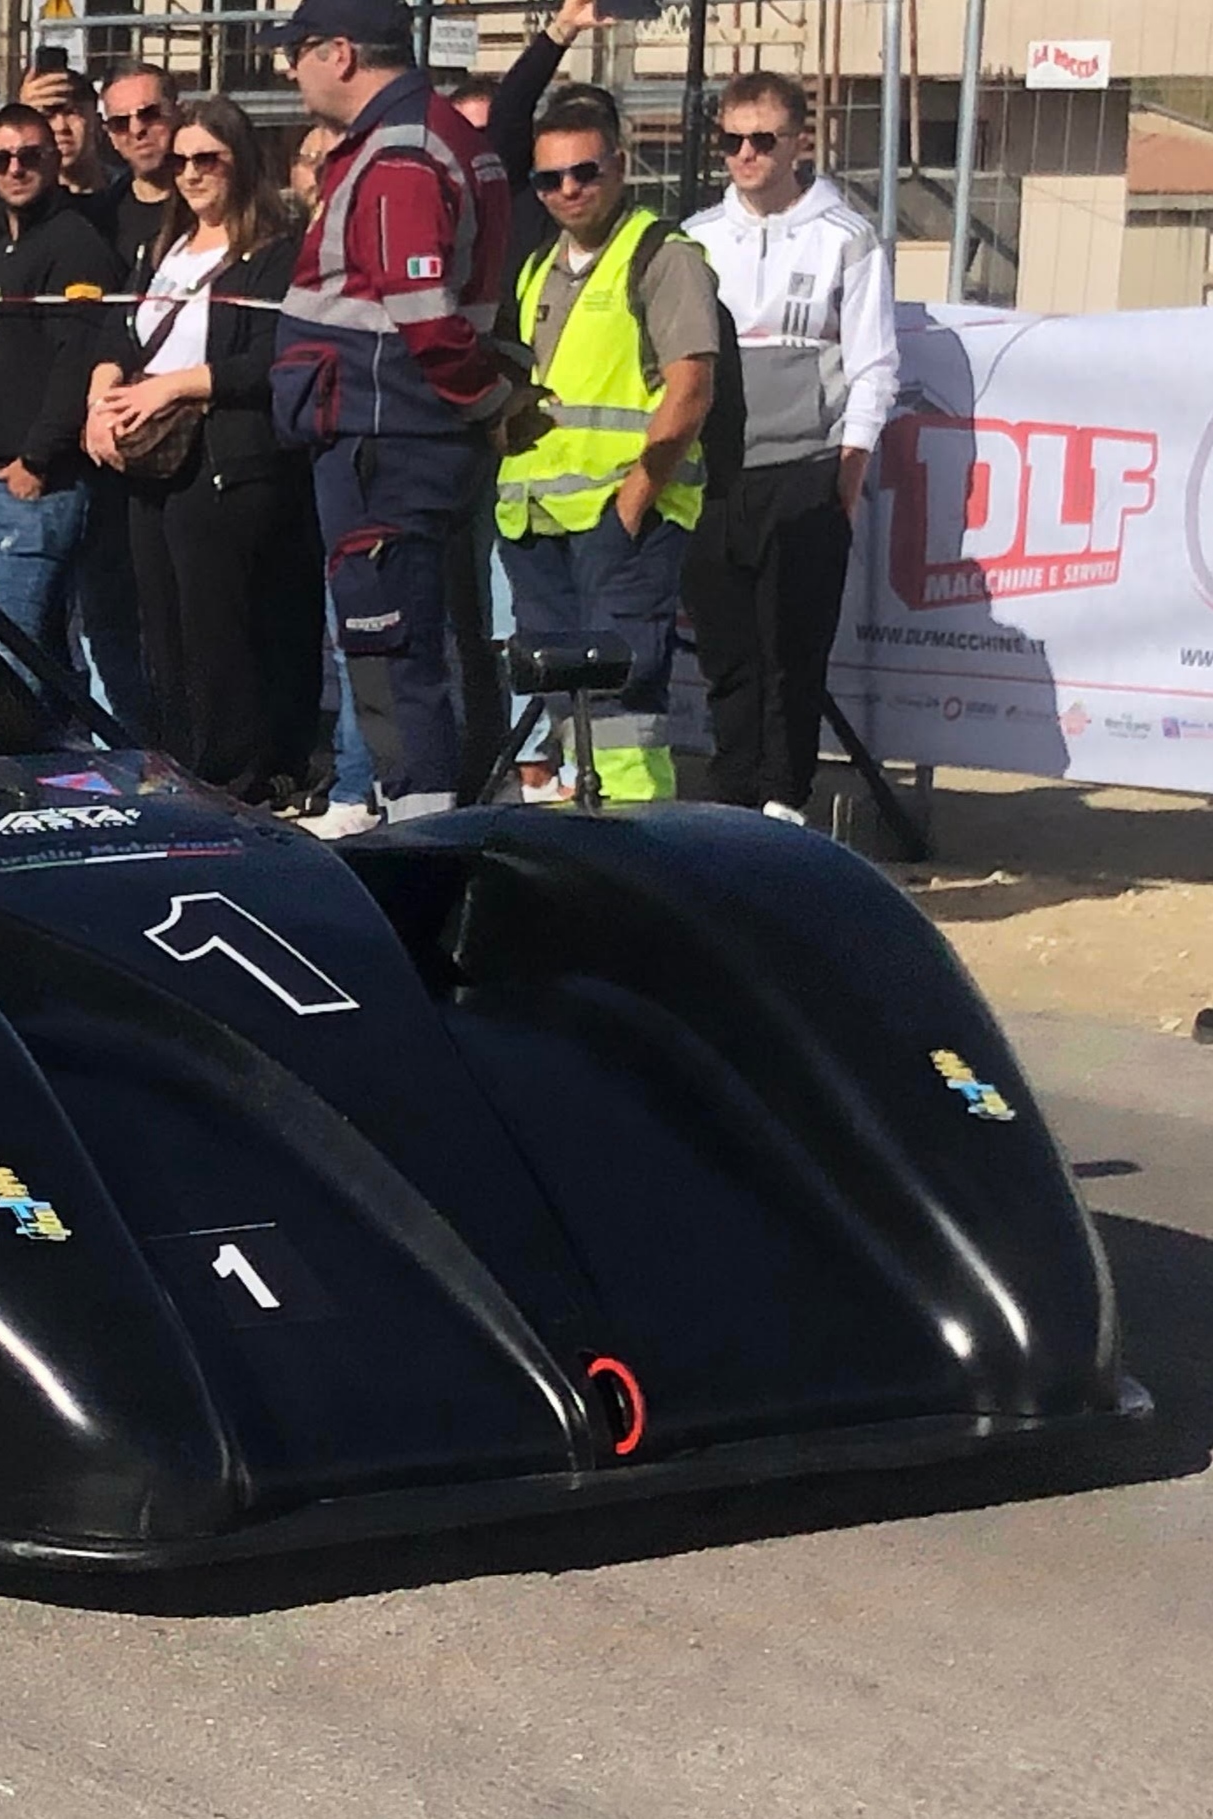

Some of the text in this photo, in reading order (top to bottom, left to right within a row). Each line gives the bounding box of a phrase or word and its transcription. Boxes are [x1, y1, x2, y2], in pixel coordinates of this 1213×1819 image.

[916, 426, 1154, 565] DLF
[924, 566, 1044, 602] MACCHINE
[143, 891, 361, 1015] 1
[212, 1244, 281, 1308] 1
